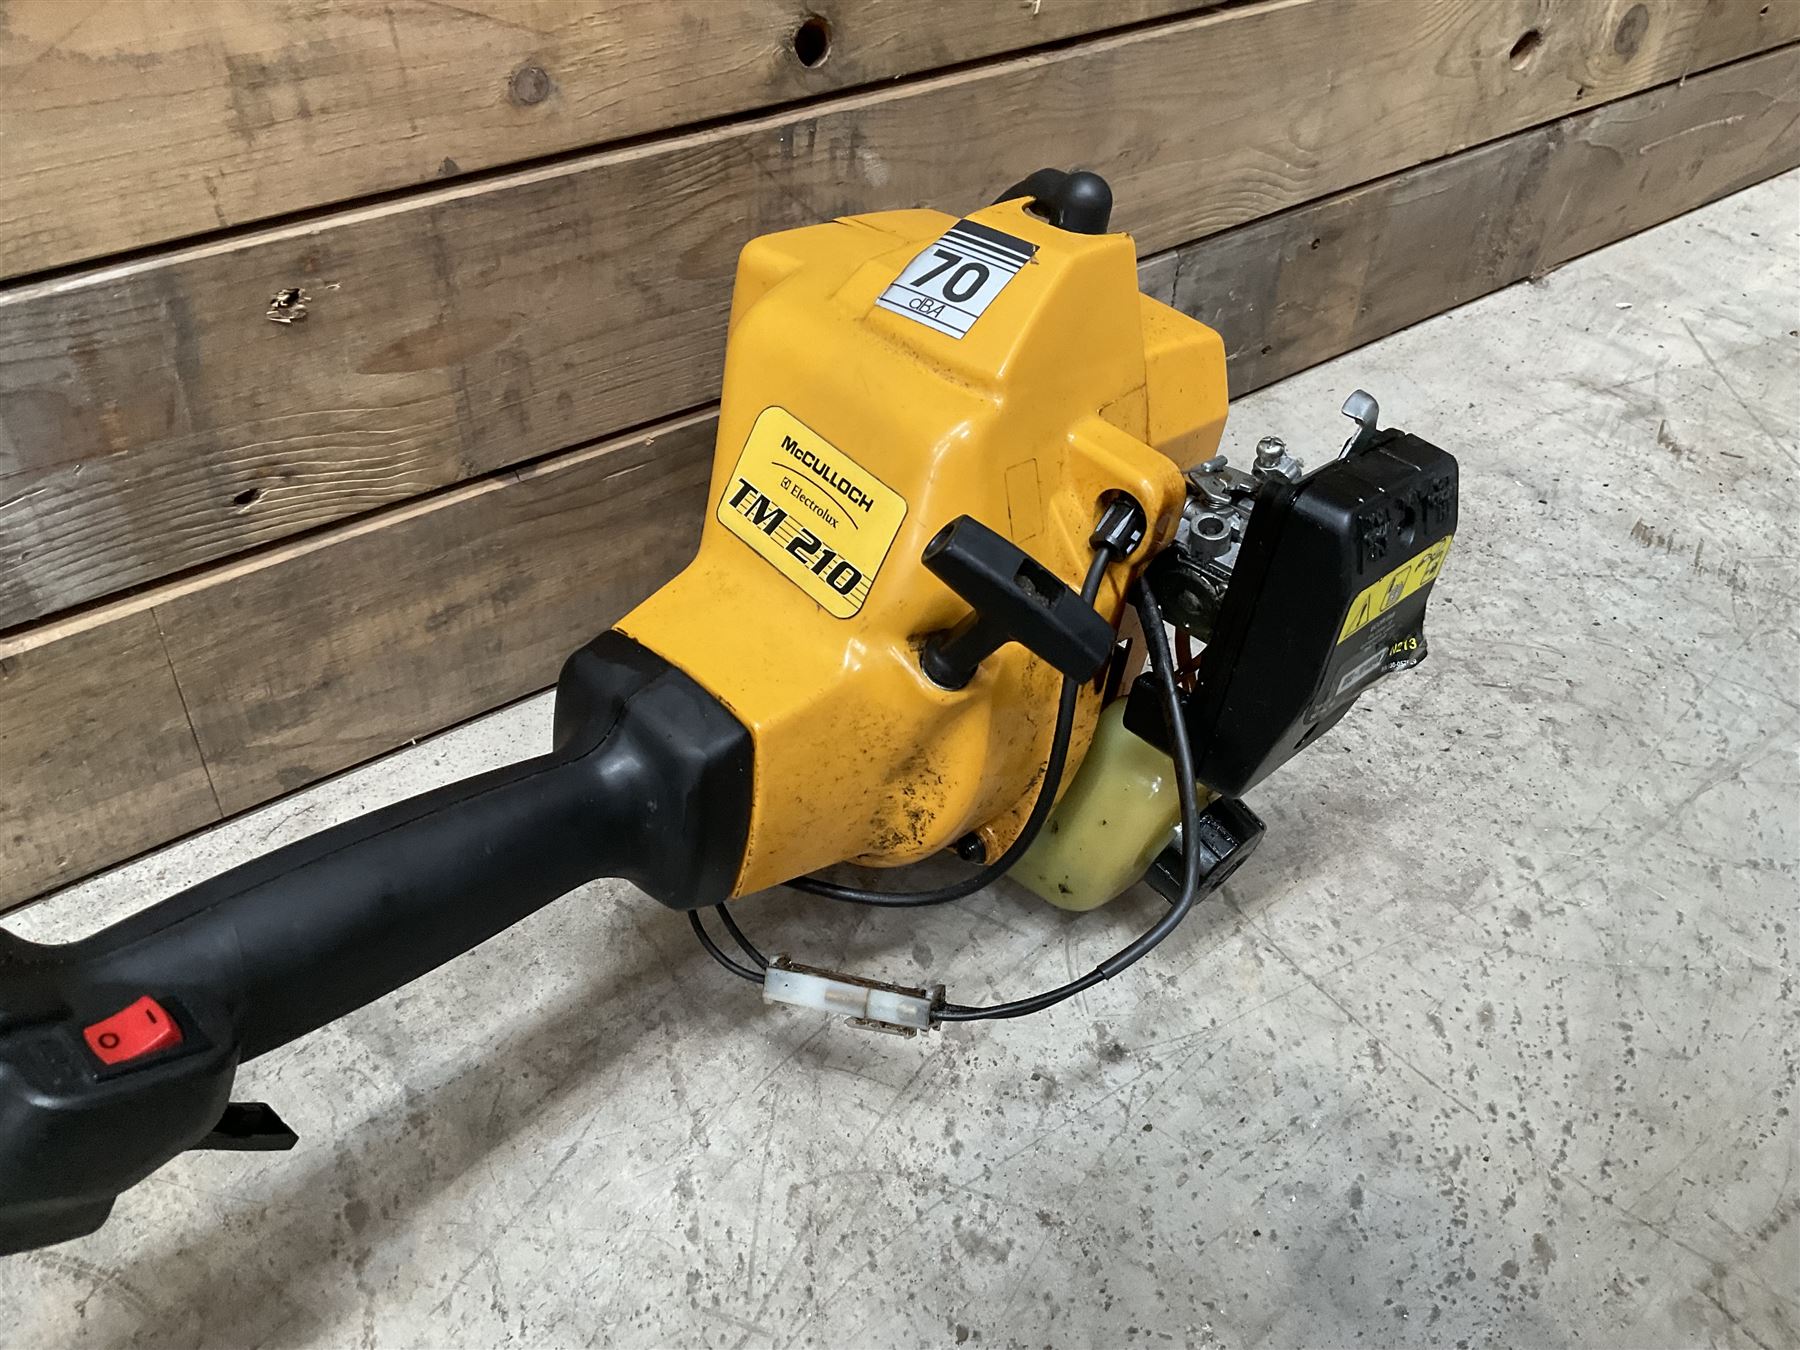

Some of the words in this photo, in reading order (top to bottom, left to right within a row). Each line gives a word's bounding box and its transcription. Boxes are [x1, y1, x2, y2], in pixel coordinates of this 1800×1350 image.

[910, 249, 990, 303] 70
[908, 297, 946, 319] dBA
[780, 435, 875, 512] McCULLOCH
[790, 483, 840, 529] Electrolux
[728, 478, 788, 537] TM
[785, 528, 863, 596] 210
